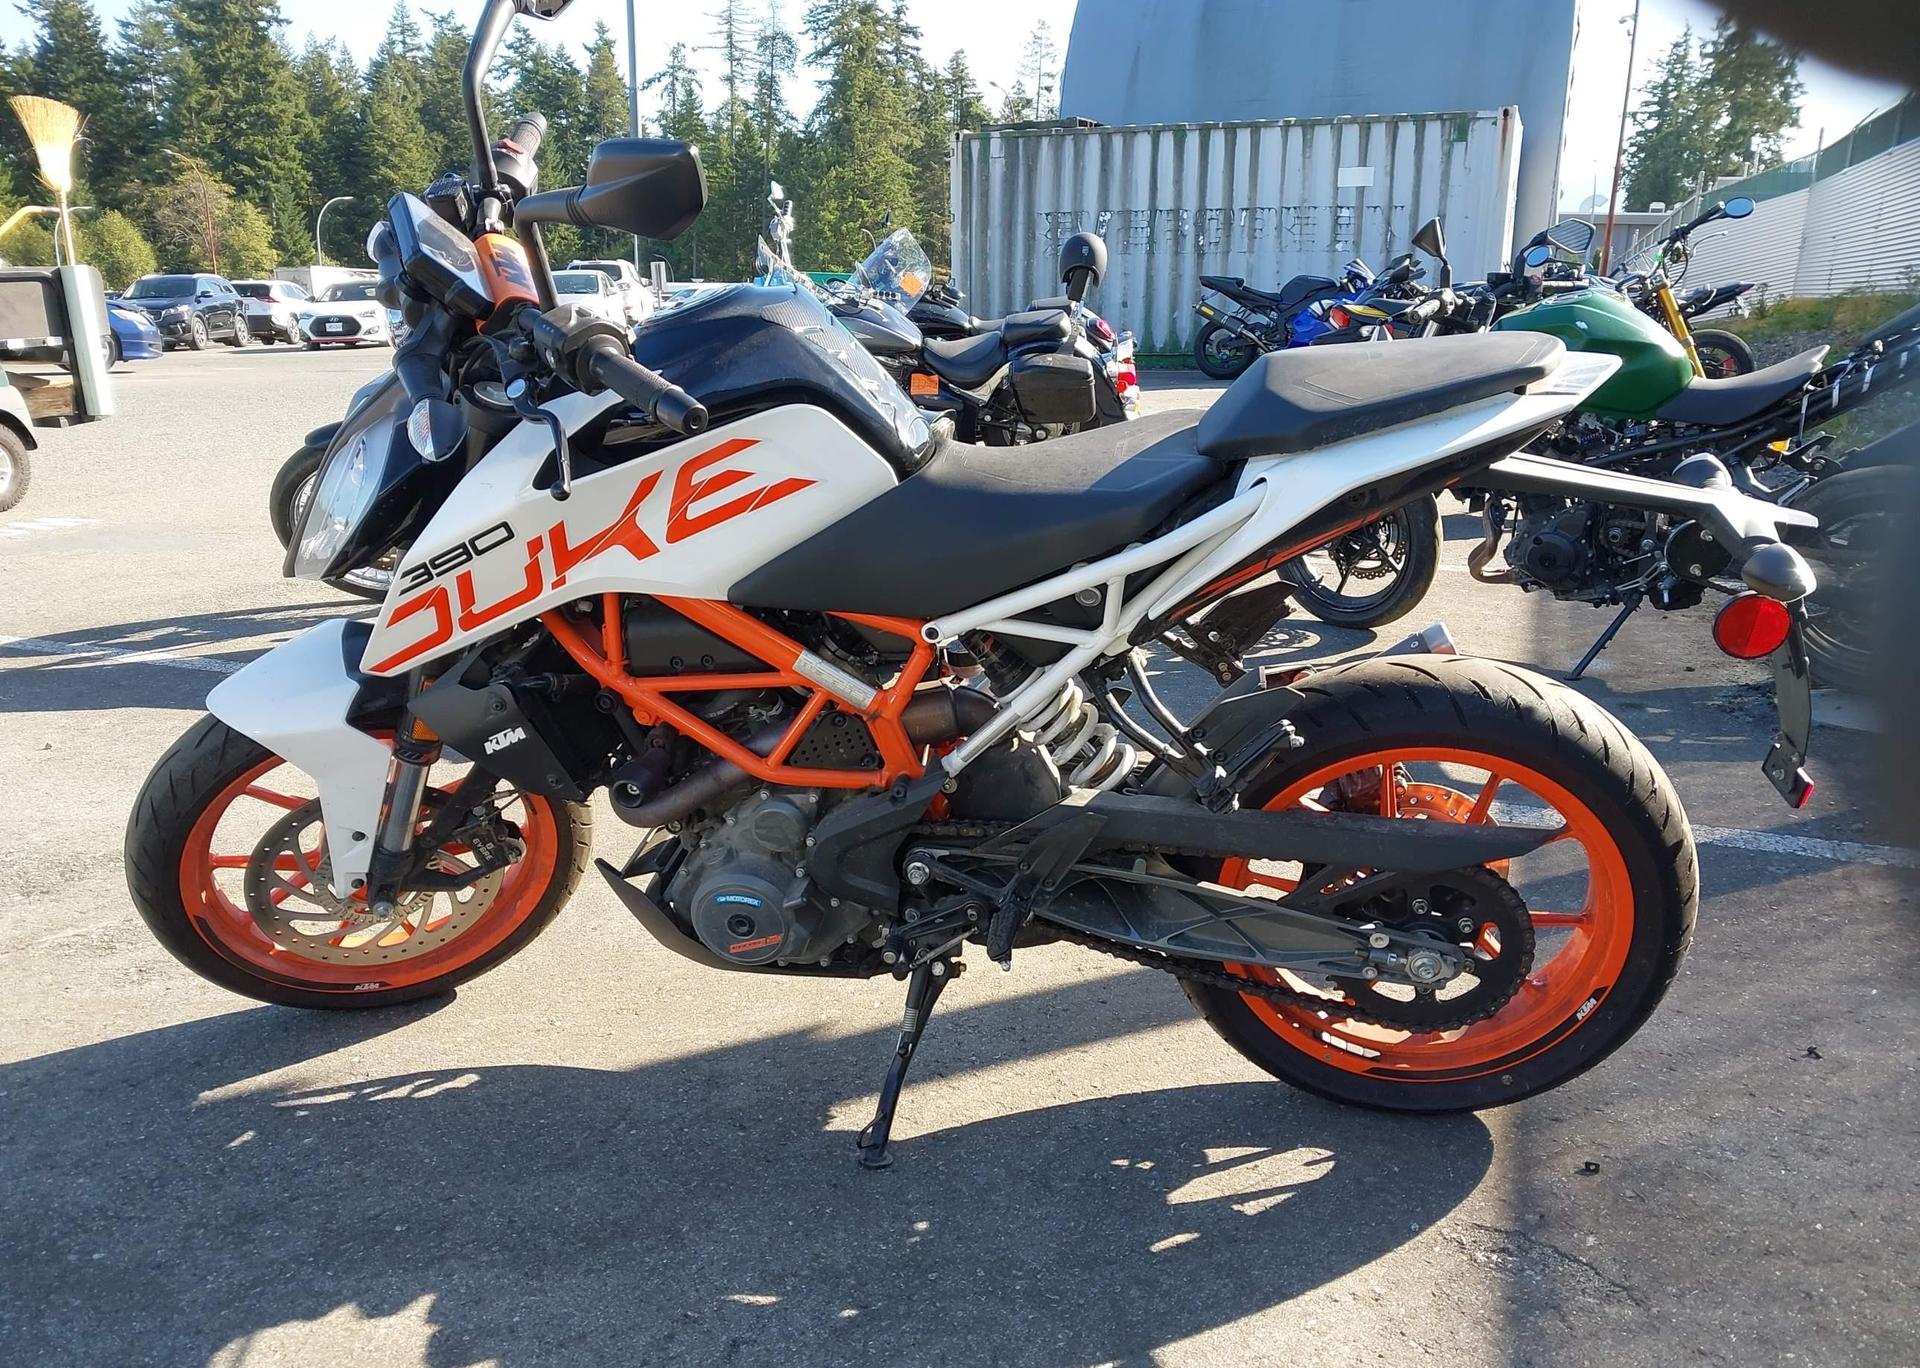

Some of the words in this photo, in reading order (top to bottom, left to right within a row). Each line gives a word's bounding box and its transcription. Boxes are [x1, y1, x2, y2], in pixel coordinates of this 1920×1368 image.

[369, 438, 818, 673] DUKE
[398, 520, 516, 598] 390
[483, 726, 527, 755] KTM
[726, 895, 760, 907] MOTOREX
[1576, 997, 1597, 1020] KTM
